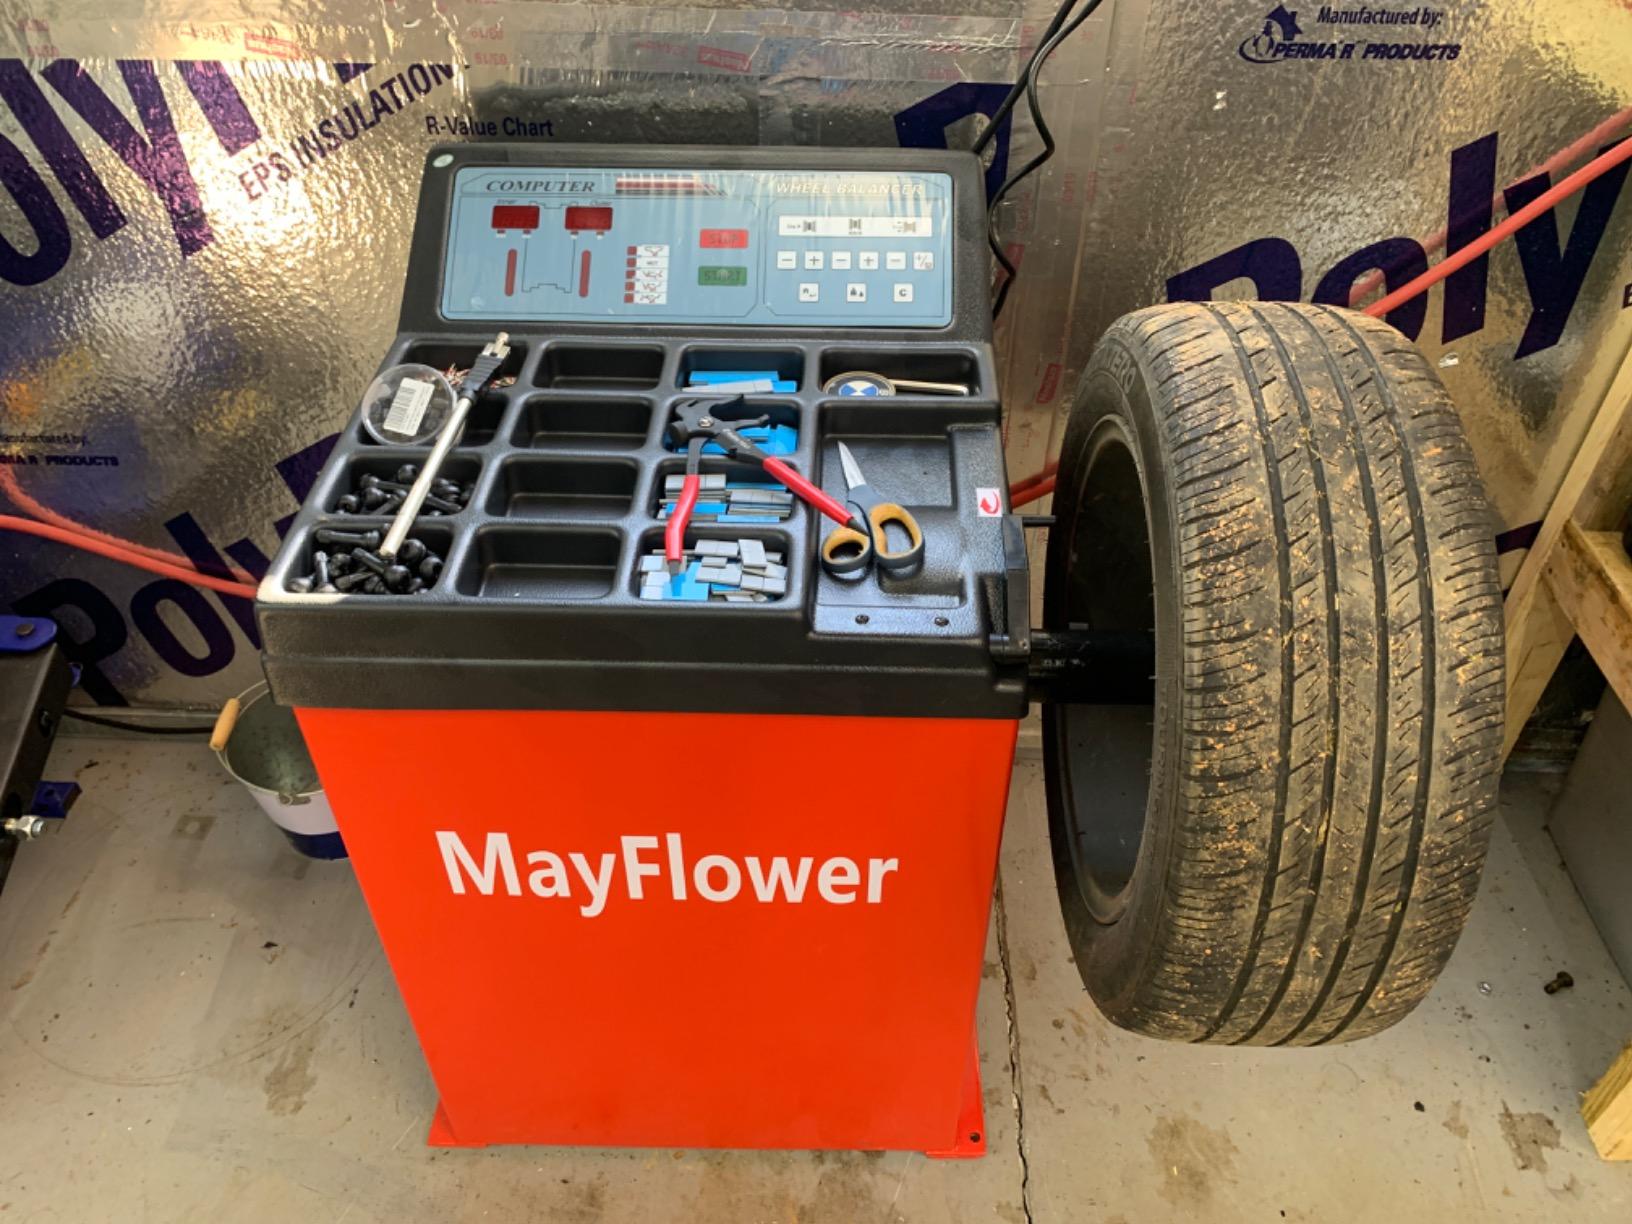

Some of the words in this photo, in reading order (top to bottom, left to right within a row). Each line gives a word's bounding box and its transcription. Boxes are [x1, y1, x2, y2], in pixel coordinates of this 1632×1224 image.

[1316, 5, 1419, 26] Manufactured
[1420, 7, 1444, 29] by:
[1271, 42, 1336, 60] PERMA
[1361, 43, 1462, 61] PRODUCTS
[425, 115, 497, 138] R-Value
[502, 116, 554, 138] Chart
[238, 152, 292, 201] EPS
[486, 180, 596, 193] COMPUTER
[776, 182, 831, 195] WHEEL
[836, 182, 924, 196] BALANCER
[45, 454, 119, 467] PRODUCTS
[434, 830, 899, 918] MayFlower
